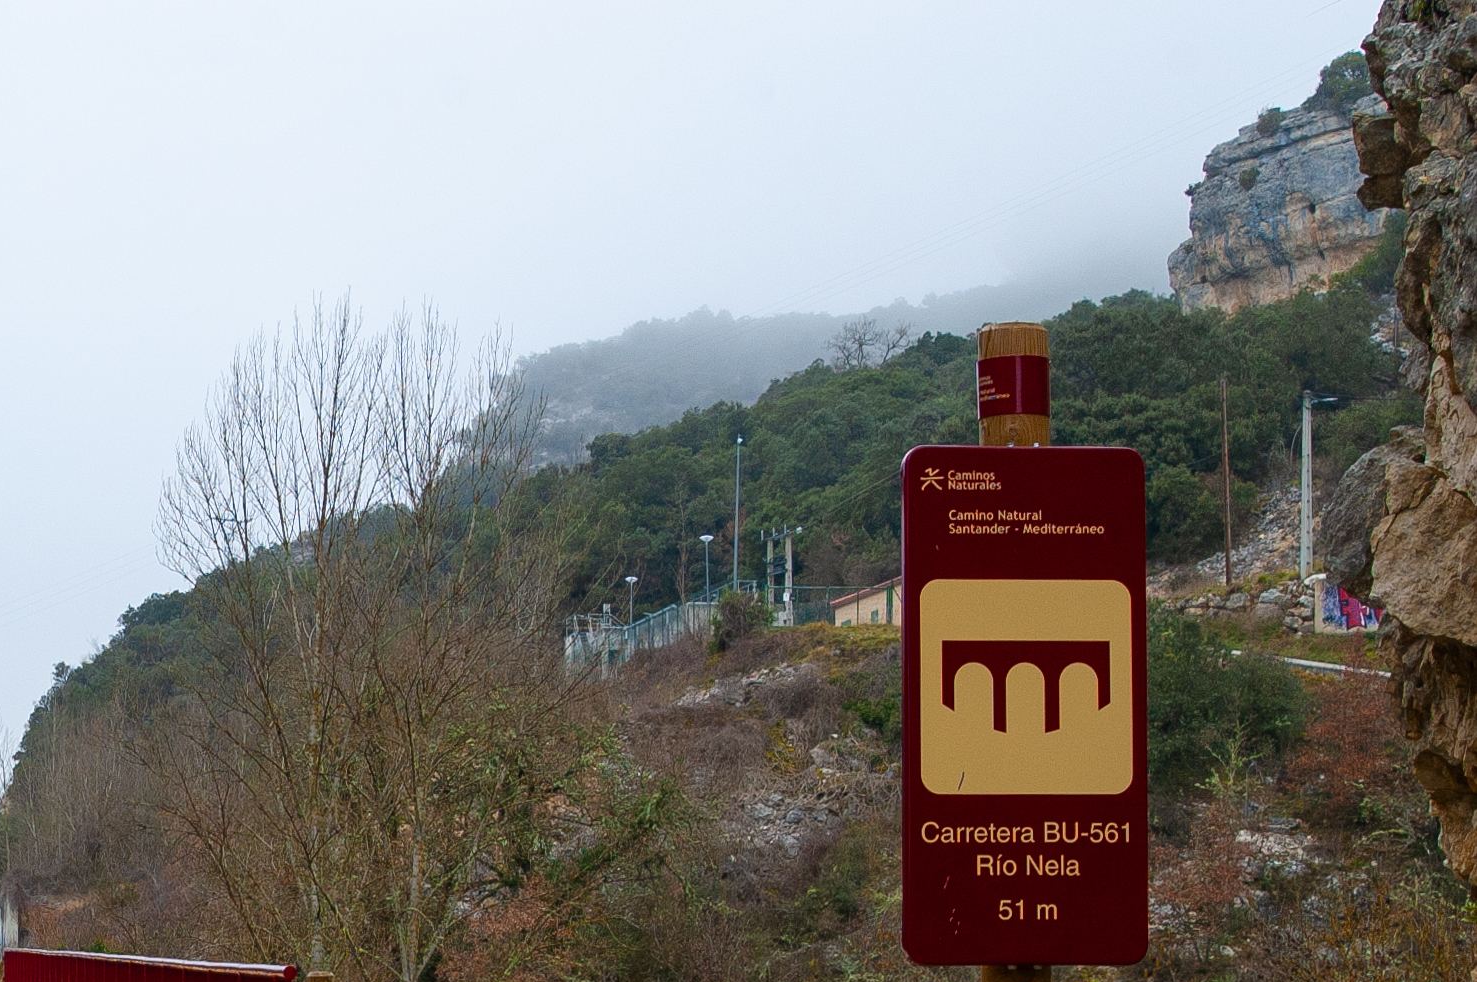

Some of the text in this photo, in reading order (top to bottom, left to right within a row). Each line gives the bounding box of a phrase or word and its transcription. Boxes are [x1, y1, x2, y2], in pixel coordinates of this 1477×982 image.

[947, 470, 995, 480] Caminos
[947, 480, 1001, 490] Naturales
[948, 510, 1042, 521] Camino Natural
[948, 523, 1011, 534] Santander
[1022, 523, 1105, 535] Mediterráneo
[921, 821, 1130, 843] Carretera BU-561
[976, 854, 1081, 876] Río Nela
[998, 899, 1058, 920] 51 m
